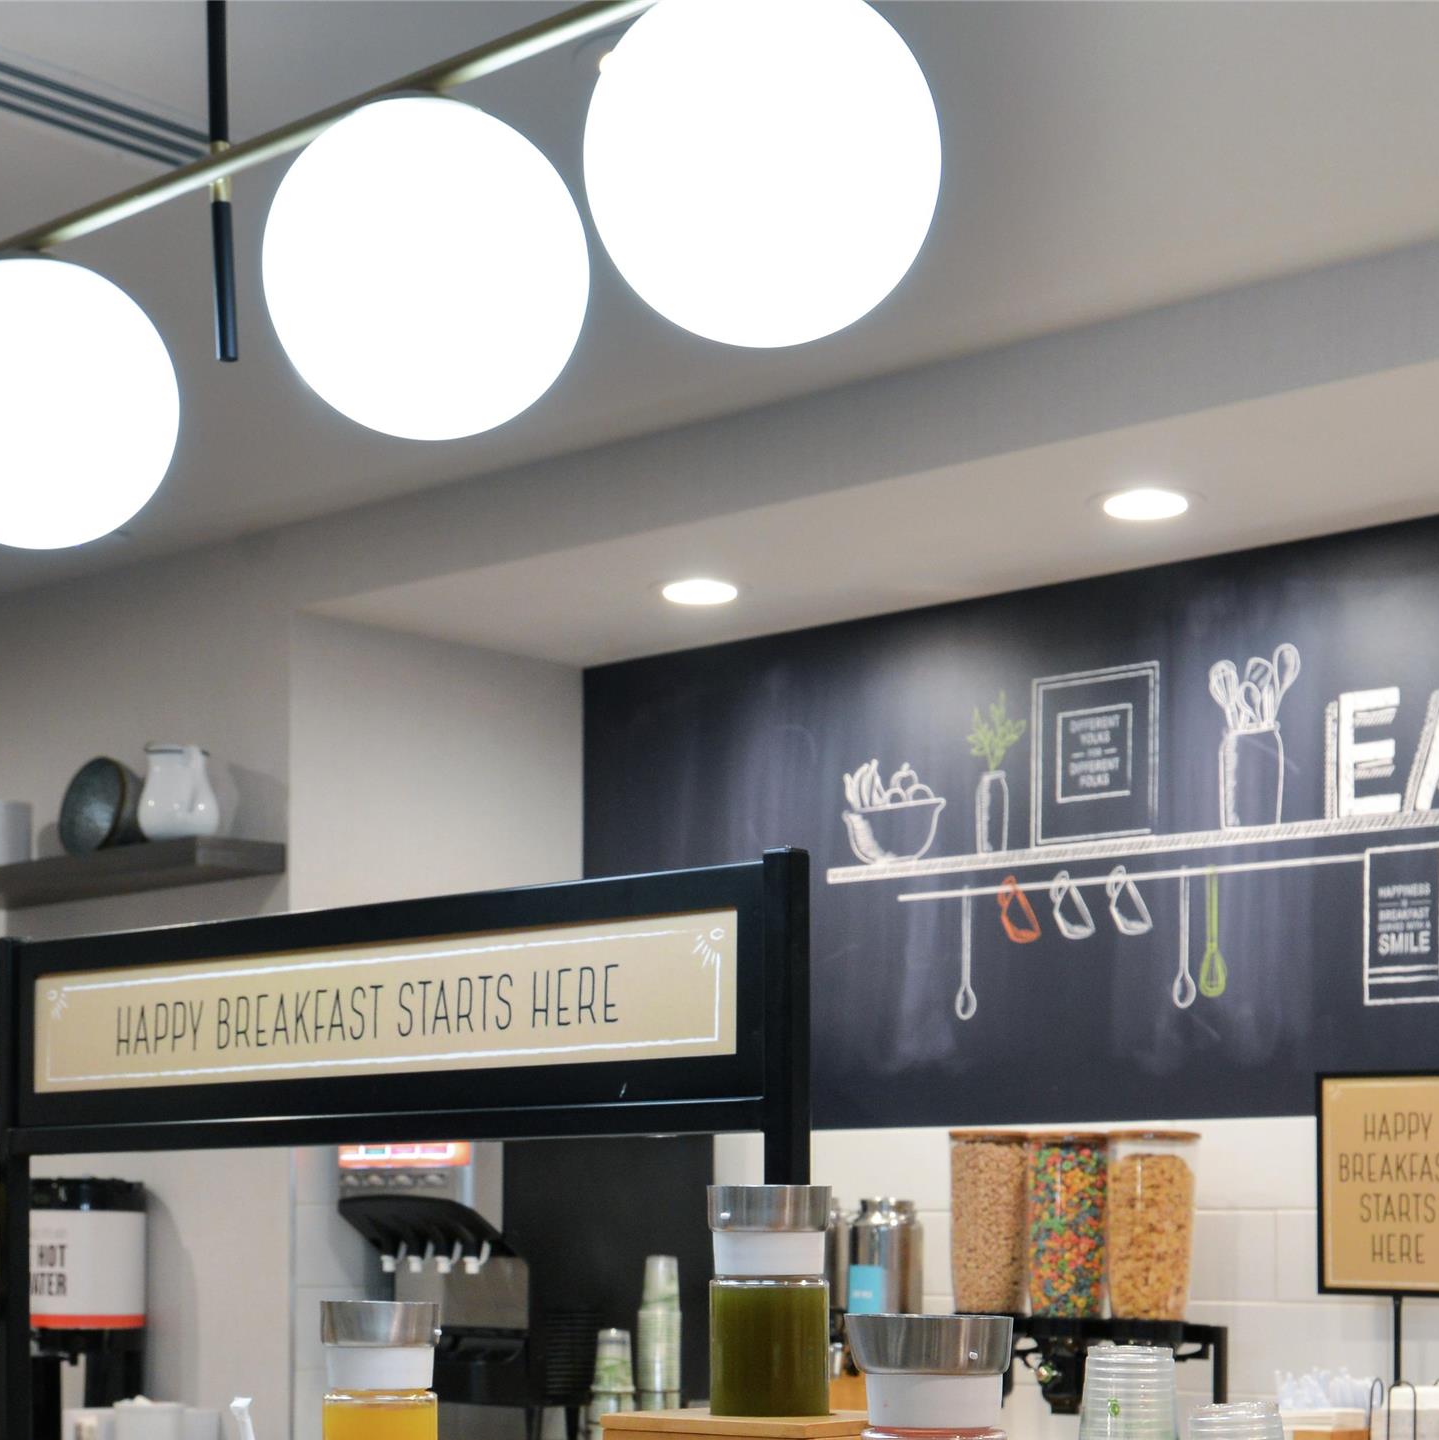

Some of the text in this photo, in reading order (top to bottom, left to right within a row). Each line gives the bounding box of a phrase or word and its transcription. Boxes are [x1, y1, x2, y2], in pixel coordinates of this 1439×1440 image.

[1378, 930, 1431, 956] SMILE
[116, 964, 619, 1056] HAPPY BREAKFAST STARTS HERE
[1364, 1112, 1433, 1142] HAPPY
[1360, 1193, 1437, 1224] STARTS
[36, 1244, 67, 1268] HOT
[1372, 1233, 1426, 1264] HERE
[29, 1272, 68, 1297] ATER
